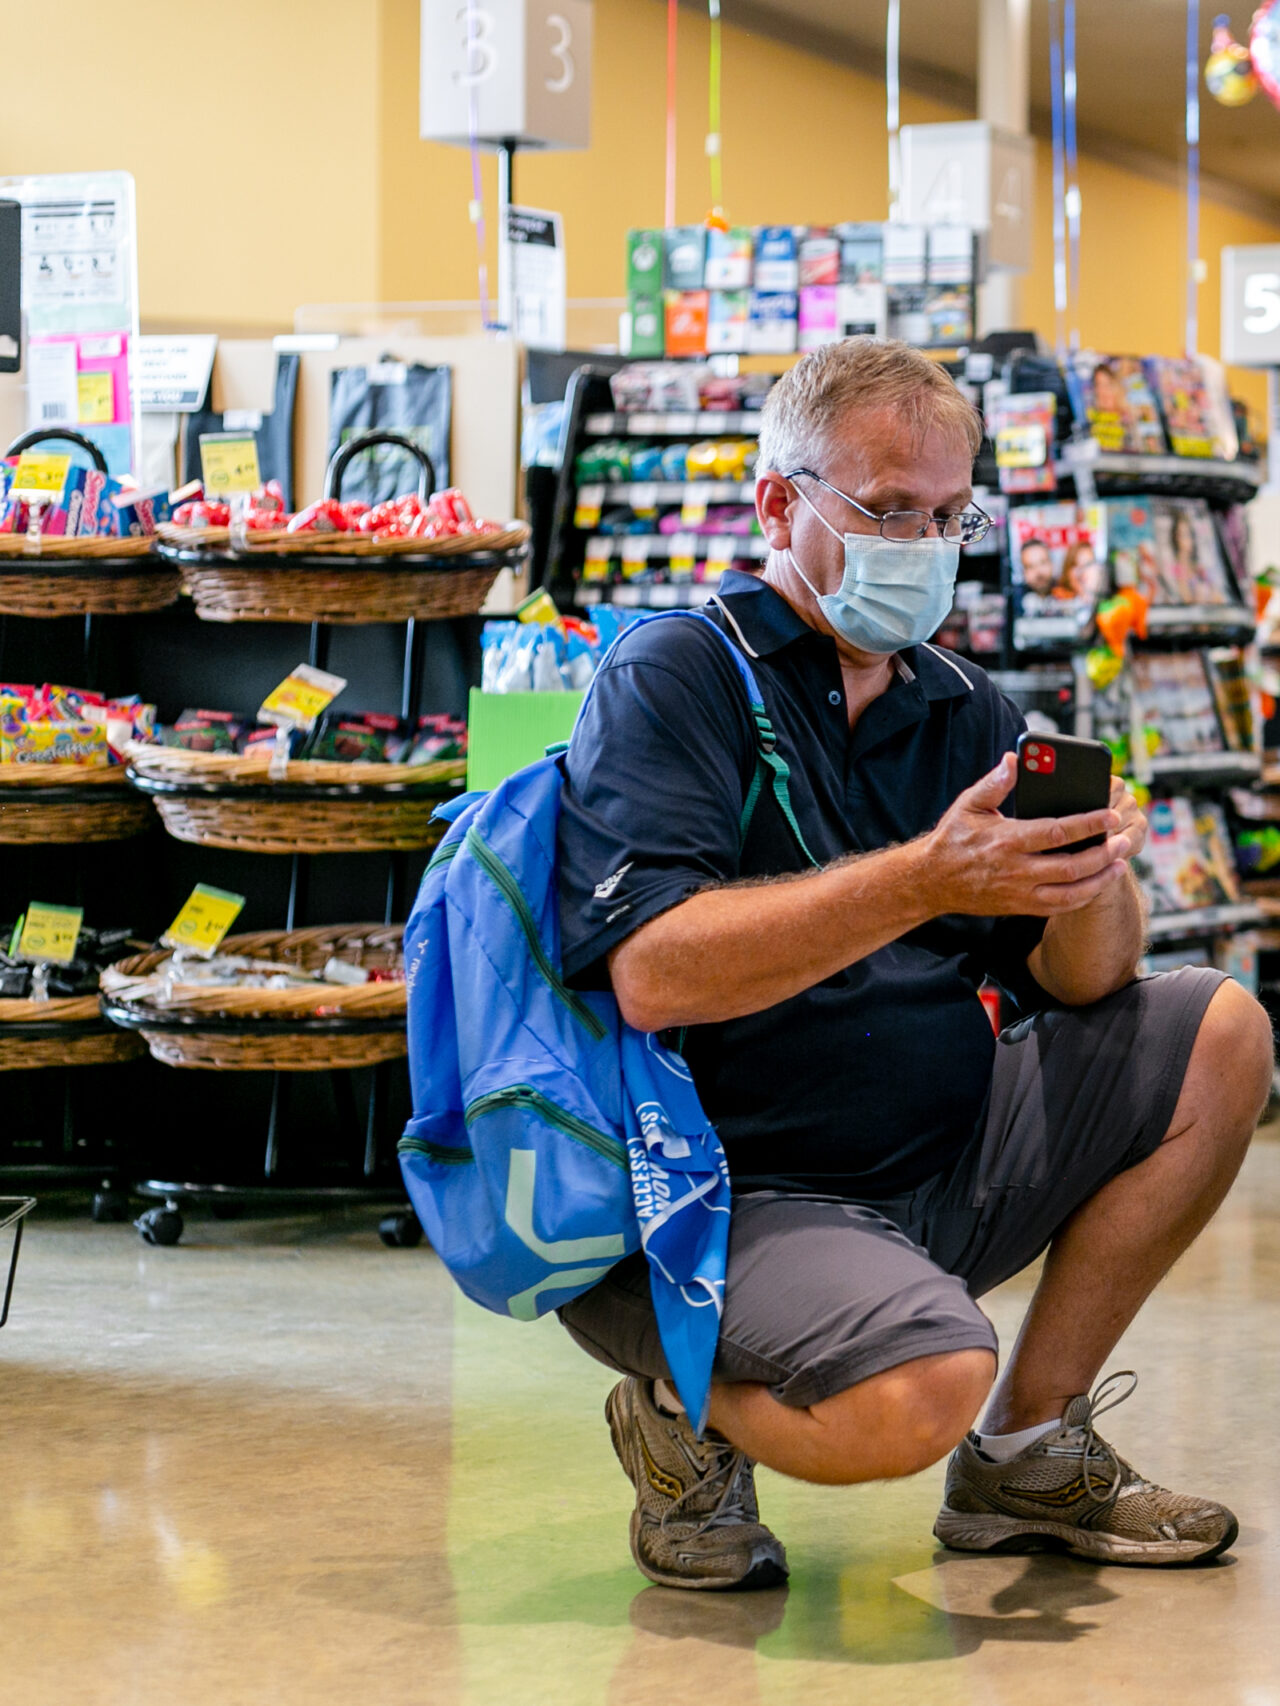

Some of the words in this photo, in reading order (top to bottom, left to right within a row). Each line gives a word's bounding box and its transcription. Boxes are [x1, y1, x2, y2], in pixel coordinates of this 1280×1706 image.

[453, 8, 498, 88] 3
[545, 14, 574, 93] 3
[922, 158, 967, 224] 4
[994, 165, 1023, 226] 4
[629, 1146, 655, 1219] ACCESS
